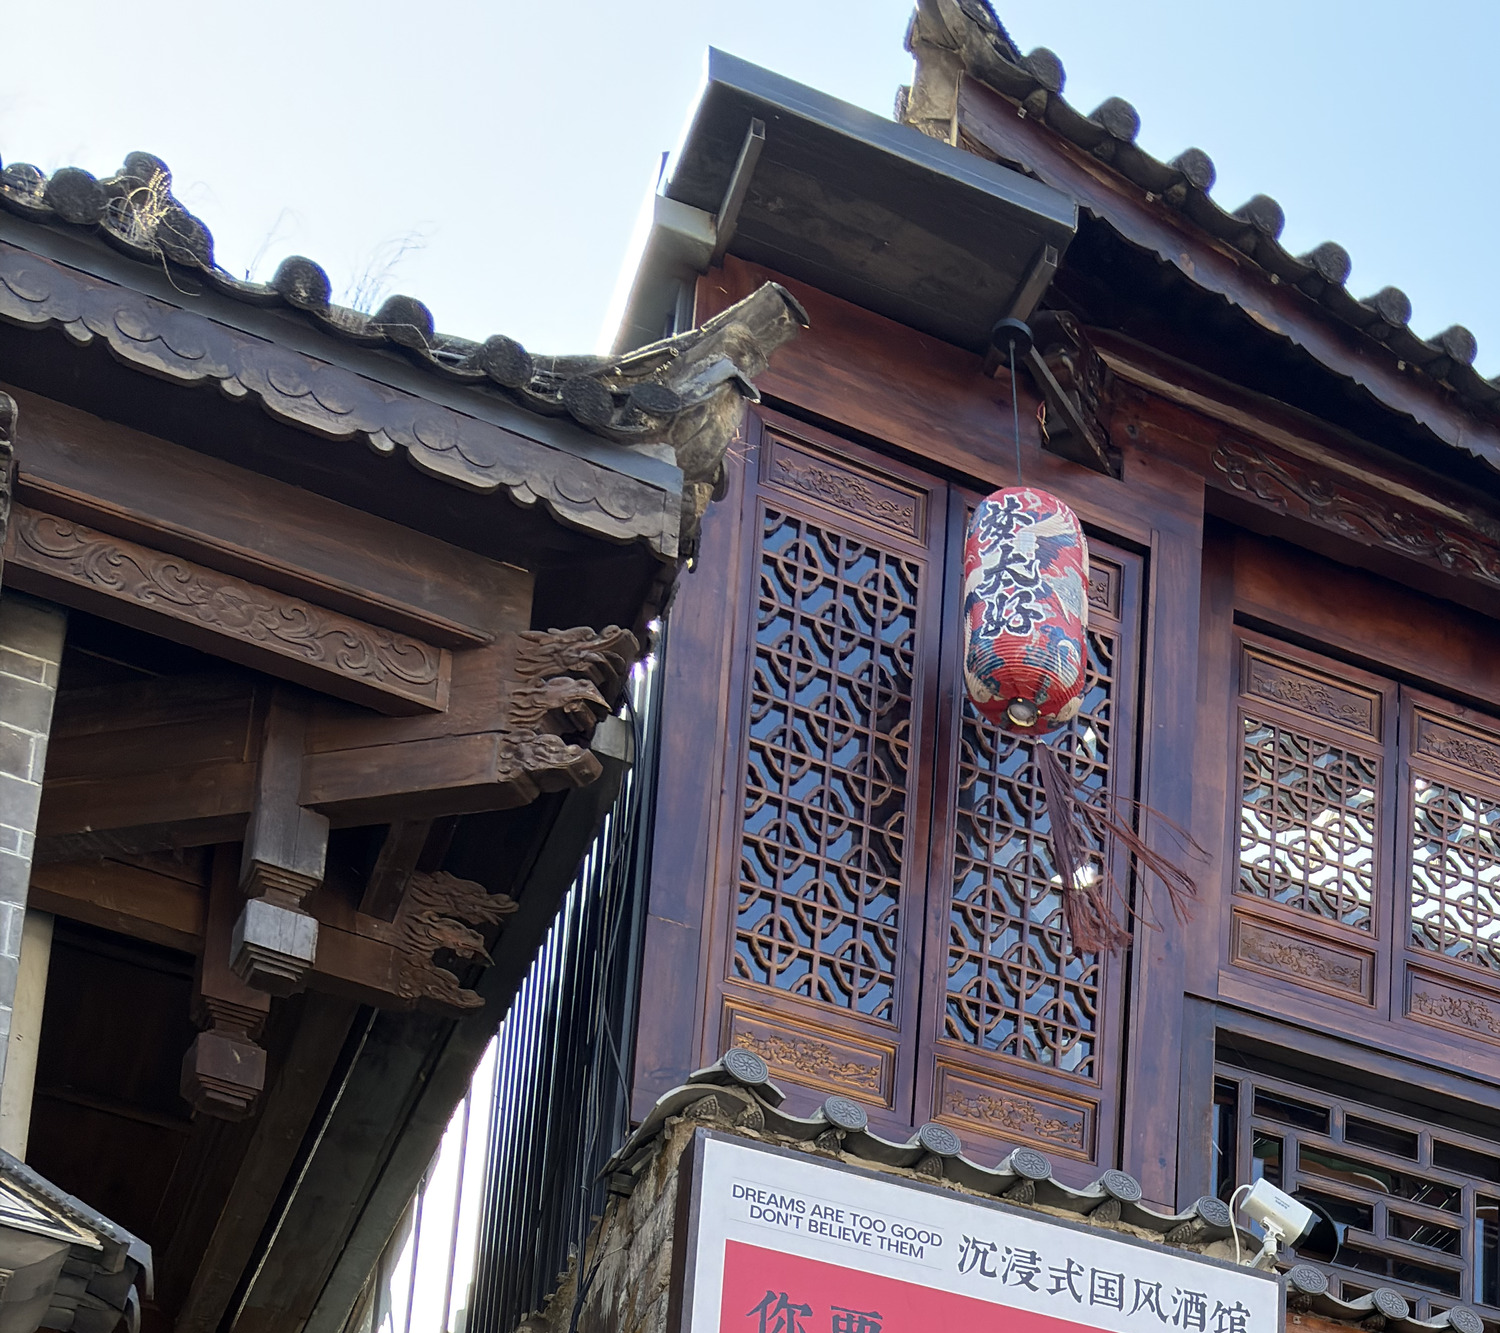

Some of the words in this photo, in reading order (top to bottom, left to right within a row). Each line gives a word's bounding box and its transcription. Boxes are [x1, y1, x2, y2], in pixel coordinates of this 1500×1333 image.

[732, 1184, 806, 1214] DREAMS
[810, 1204, 845, 1223] ARE
[850, 1212, 886, 1233] TOO
[890, 1223, 943, 1247] GOOD
[750, 1205, 803, 1229] DON'T
[808, 1219, 872, 1246] BELIEVE
[877, 1235, 924, 1259] THEM
